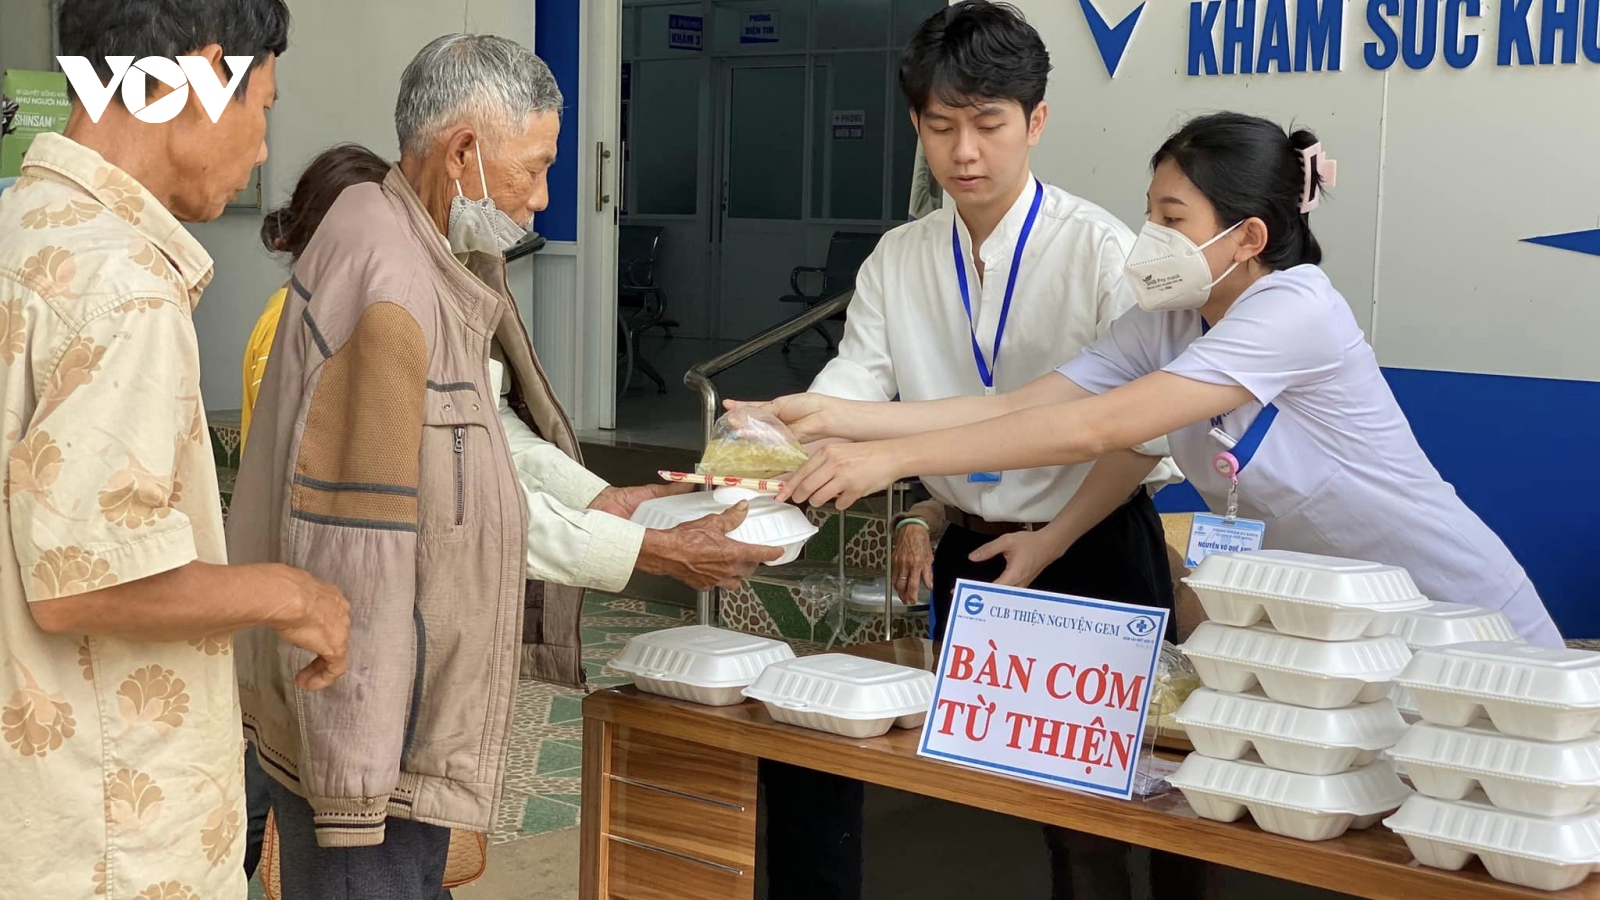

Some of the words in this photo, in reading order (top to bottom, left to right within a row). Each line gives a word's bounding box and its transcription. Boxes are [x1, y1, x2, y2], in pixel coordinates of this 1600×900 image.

[695, 35, 701, 46] 3
[14, 113, 52, 127] SHINSAM
[989, 605, 1011, 619] CLB
[1012, 609, 1046, 626] THIỆN
[1046, 614, 1094, 633] NGUYỆN
[1094, 621, 1121, 637] GEM
[946, 639, 1036, 693] BÀN
[1045, 662, 1146, 712] CƠM
[937, 694, 996, 742] TỪ
[1005, 711, 1136, 774] THIỆN
